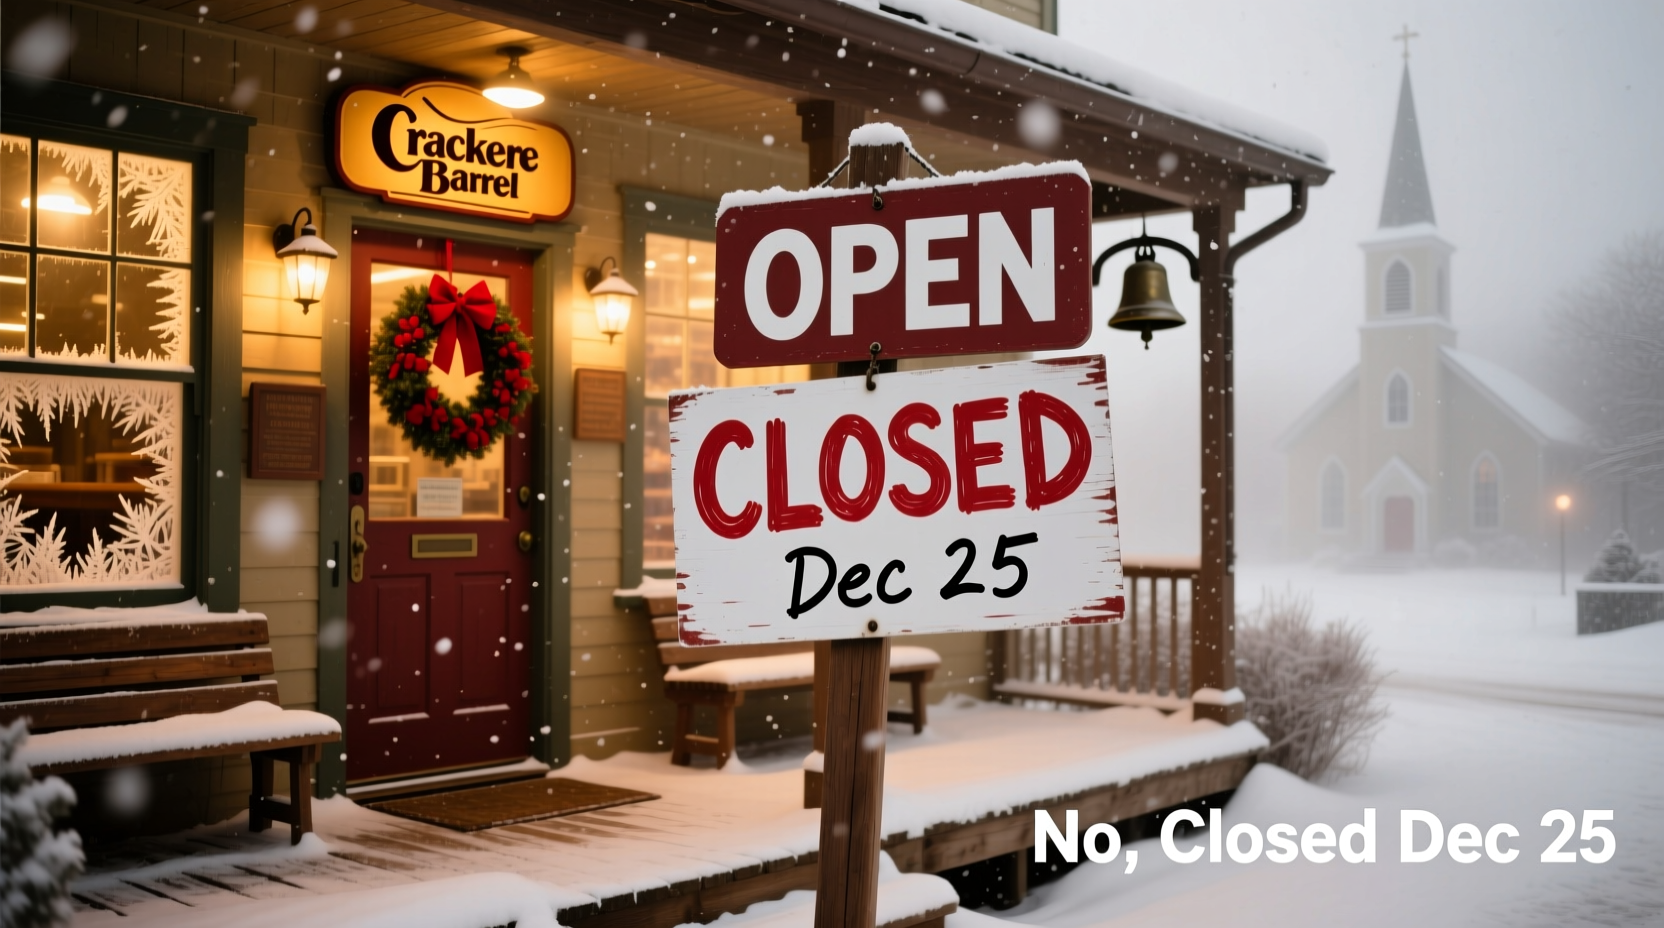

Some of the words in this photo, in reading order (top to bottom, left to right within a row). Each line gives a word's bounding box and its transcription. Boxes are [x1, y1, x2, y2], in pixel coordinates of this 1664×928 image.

[372, 104, 538, 172] Crackere
[420, 159, 518, 199] Barrel
[744, 207, 1055, 341] OPEN
[693, 390, 1092, 539] CLOSED
[786, 546, 912, 619] Dec
[940, 532, 1038, 600] 25
